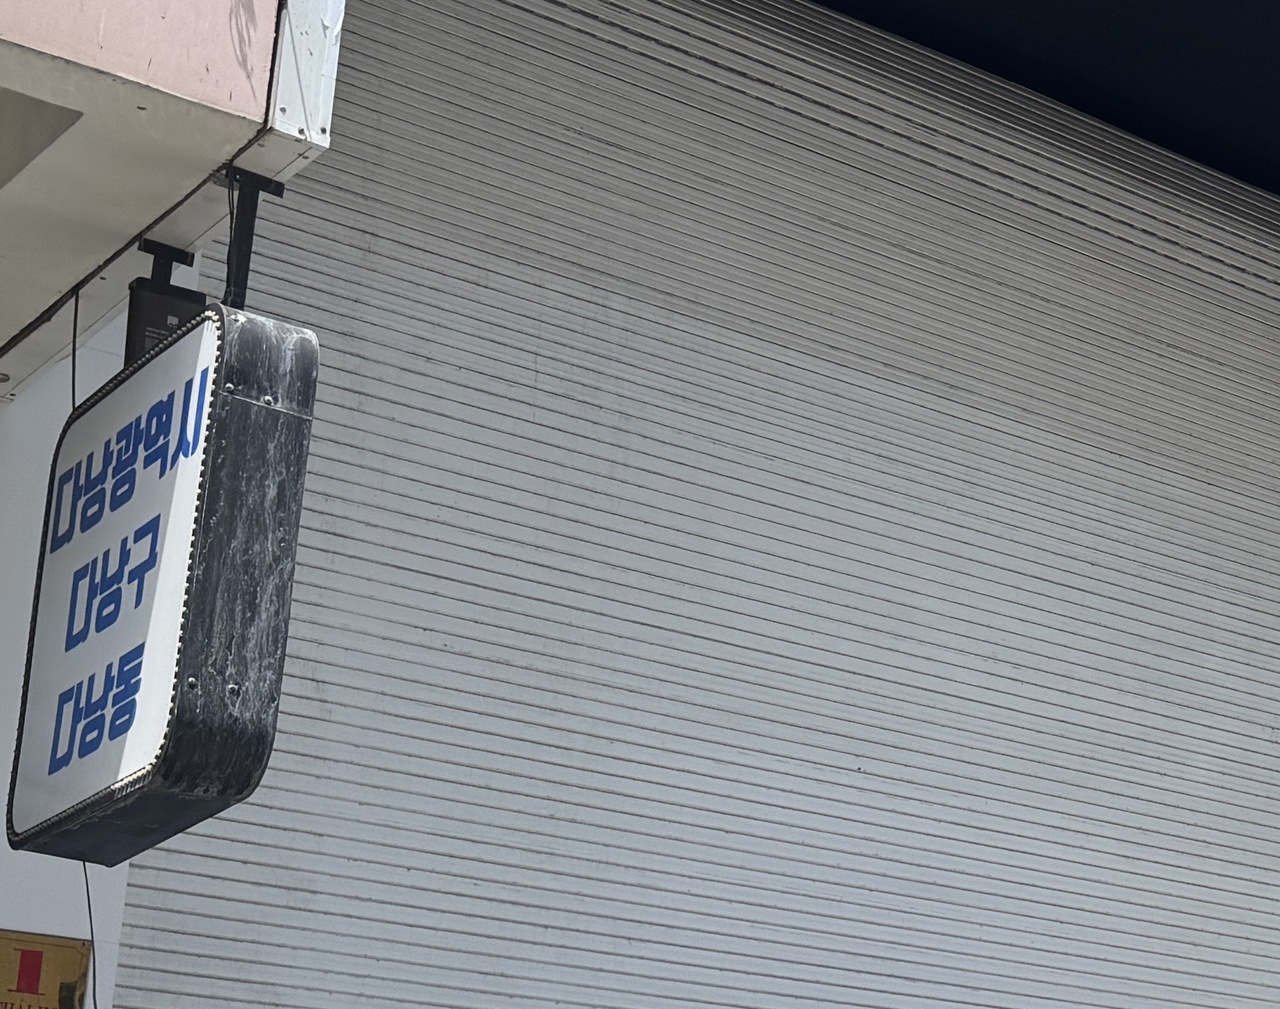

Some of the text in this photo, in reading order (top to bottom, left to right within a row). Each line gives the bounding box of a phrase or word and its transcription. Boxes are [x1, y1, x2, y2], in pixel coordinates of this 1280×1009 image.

[50, 366, 209, 554] 다낭광역시
[65, 513, 162, 653] 다낭구
[48, 642, 146, 776] 다낭동
